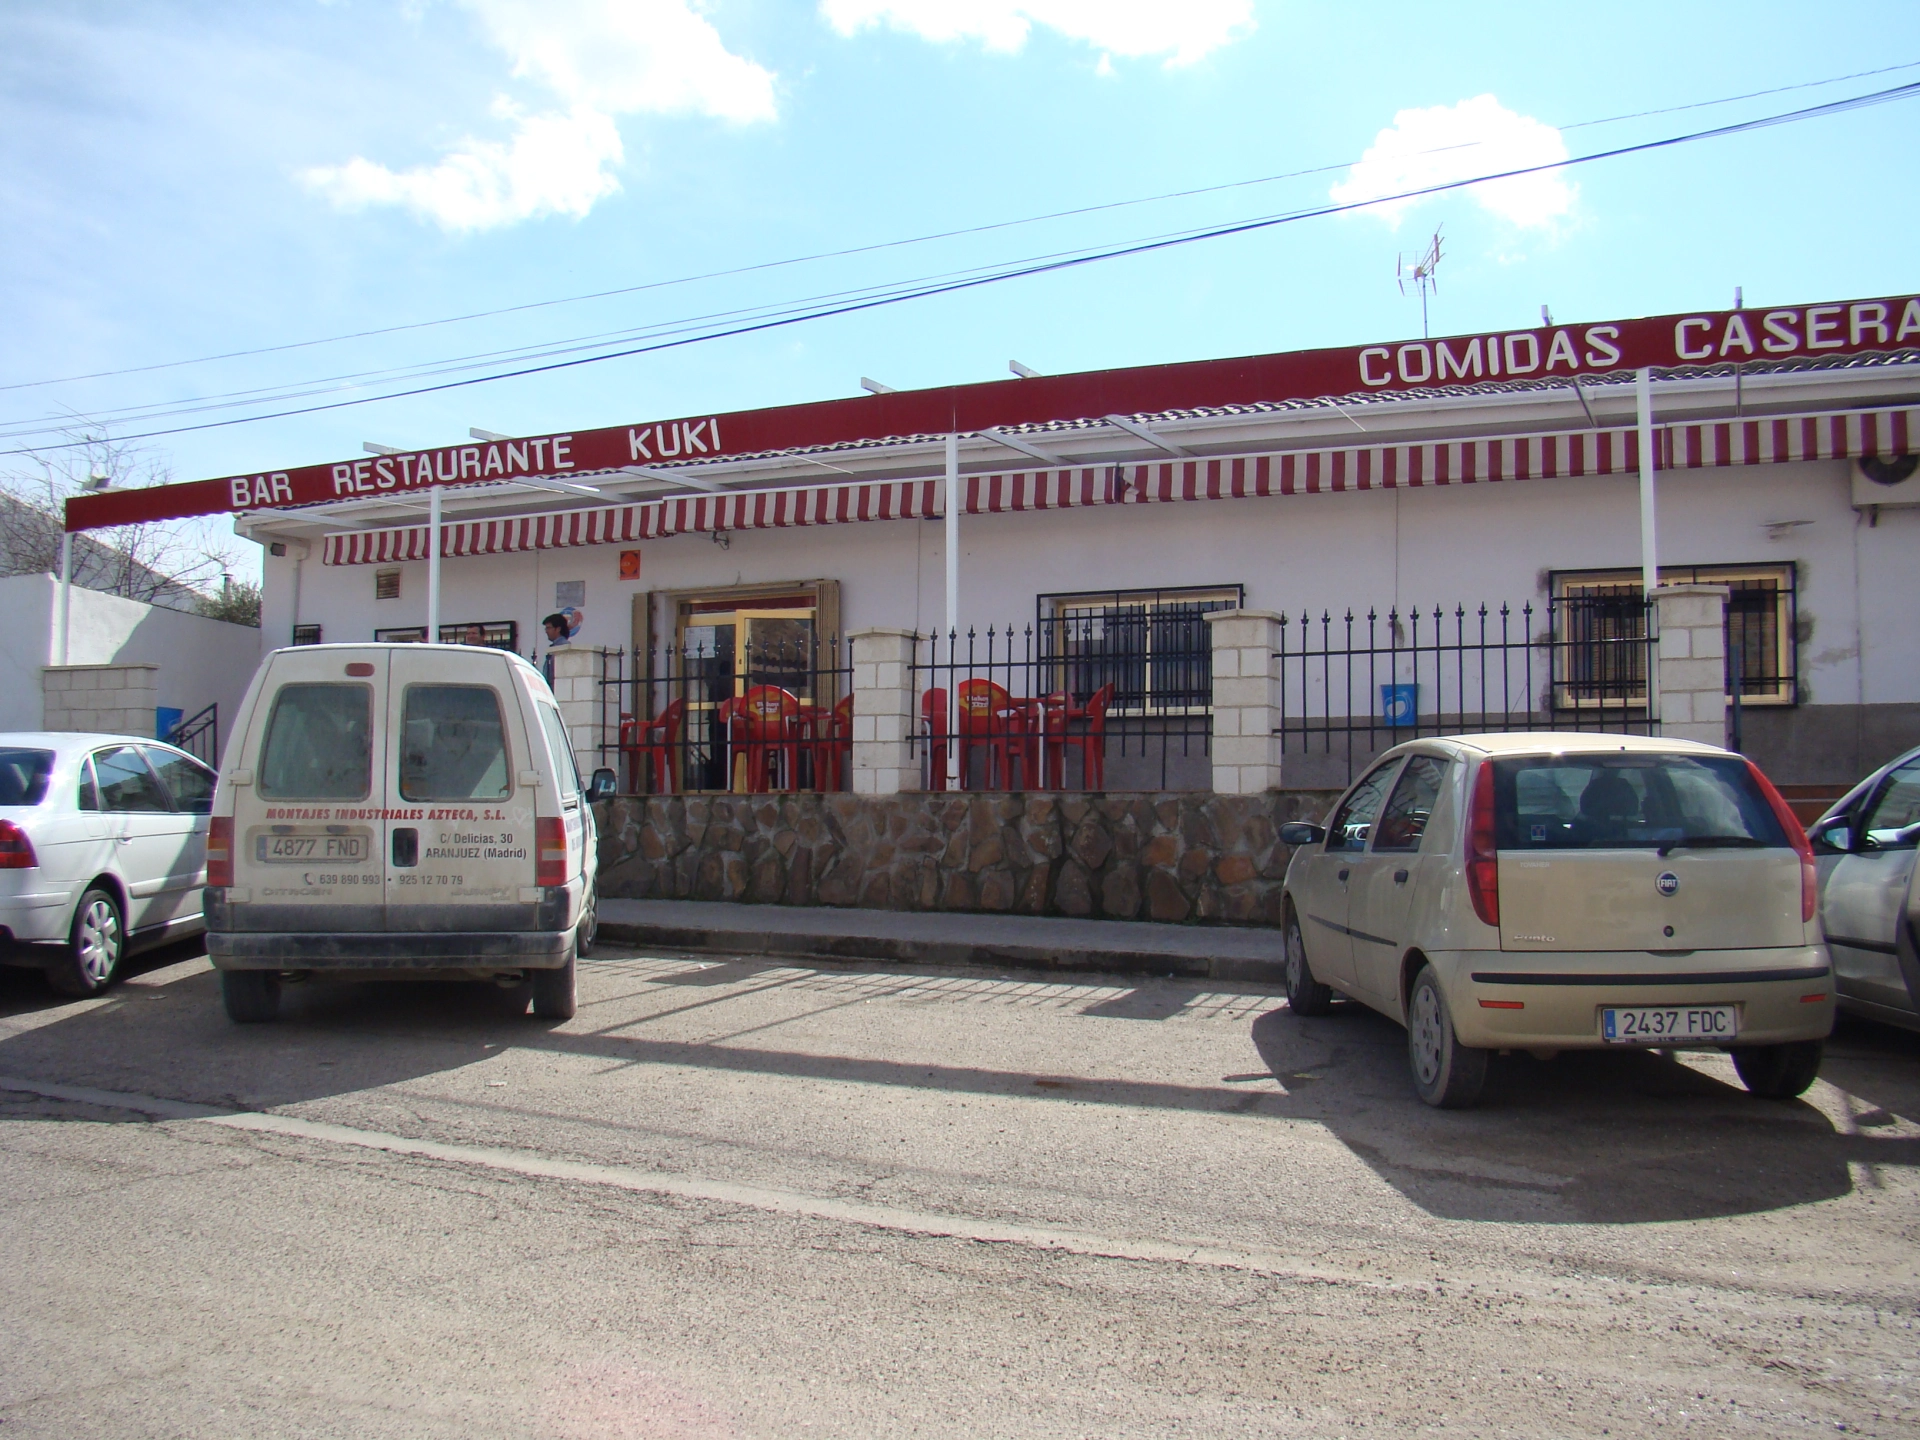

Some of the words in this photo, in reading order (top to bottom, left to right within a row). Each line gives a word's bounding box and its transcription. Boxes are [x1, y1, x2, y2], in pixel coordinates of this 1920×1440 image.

[1358, 325, 1621, 387] COMIDAS
[1674, 299, 1920, 361] CASERA
[230, 472, 294, 508] BAR
[333, 434, 576, 496] RESTAURANTE
[628, 418, 721, 461] KUKI
[266, 808, 331, 820] MONTAJES
[334, 808, 424, 820] INDUSTRIALES
[428, 809, 478, 822] AZTECA,
[484, 809, 506, 820] S.L.
[440, 833, 452, 845] C/
[454, 833, 497, 845] Delicias,
[500, 833, 513, 844] 30
[273, 839, 317, 856] 4877
[326, 839, 360, 856] FND
[426, 848, 480, 859] ARANJUEZ
[484, 848, 527, 860] (Madrid)
[319, 874, 338, 885] 639
[341, 874, 359, 885] 890
[362, 874, 380, 885] 993
[399, 875, 418, 885] 925
[421, 875, 432, 885] 12
[436, 875, 448, 885] 70
[451, 875, 463, 885] 79
[1660, 878, 1677, 888] FIAT
[1622, 1011, 1679, 1035] 2437
[1687, 1010, 1726, 1033] FDC
